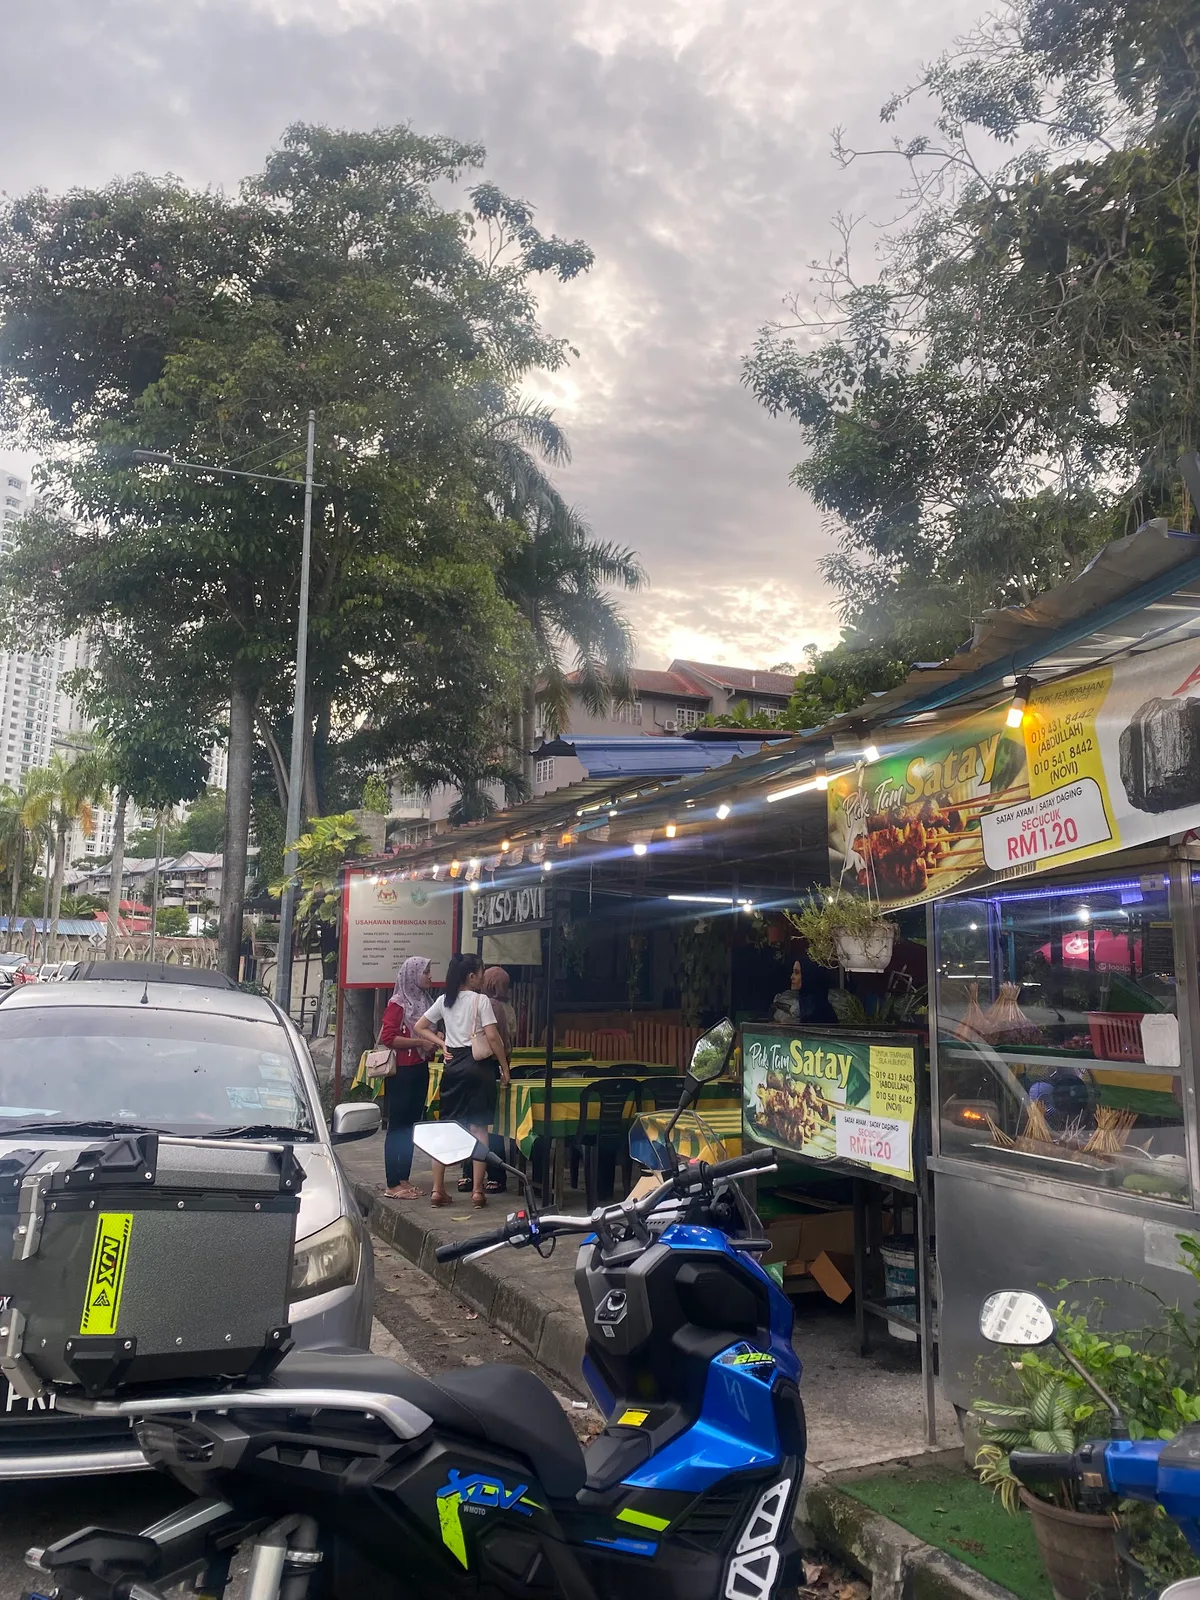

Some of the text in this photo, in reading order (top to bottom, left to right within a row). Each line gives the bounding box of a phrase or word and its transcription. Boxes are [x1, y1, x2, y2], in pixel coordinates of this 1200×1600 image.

[1029, 694, 1055, 707] NTUK
[1031, 707, 1095, 744] 019 431 8442
[1038, 722, 1084, 757] (ABDULLAH)
[1033, 738, 1093, 776] 010 541 8442
[875, 777, 904, 815] Tam
[906, 732, 1001, 803] Satay
[1050, 761, 1079, 785] (NOVI)
[996, 811, 1015, 825] SATAY
[1015, 805, 1035, 819] AYAM
[1039, 798, 1055, 812] SATAY
[1055, 786, 1083, 805] DAGING
[1021, 808, 1062, 832] SECUCUK
[1006, 817, 1079, 861] RM1.20
[514, 887, 546, 923] NOVI
[749, 1039, 853, 1090] Pak Tam Satay
[875, 1071, 913, 1083] 019 431 8442
[875, 1091, 913, 1105] 010 541 8442
[858, 1127, 882, 1139] SECUC
[869, 1121, 881, 1129] SATAY
[849, 1135, 892, 1160] RM1.20
[463, 1505, 486, 1516] WMOTO
